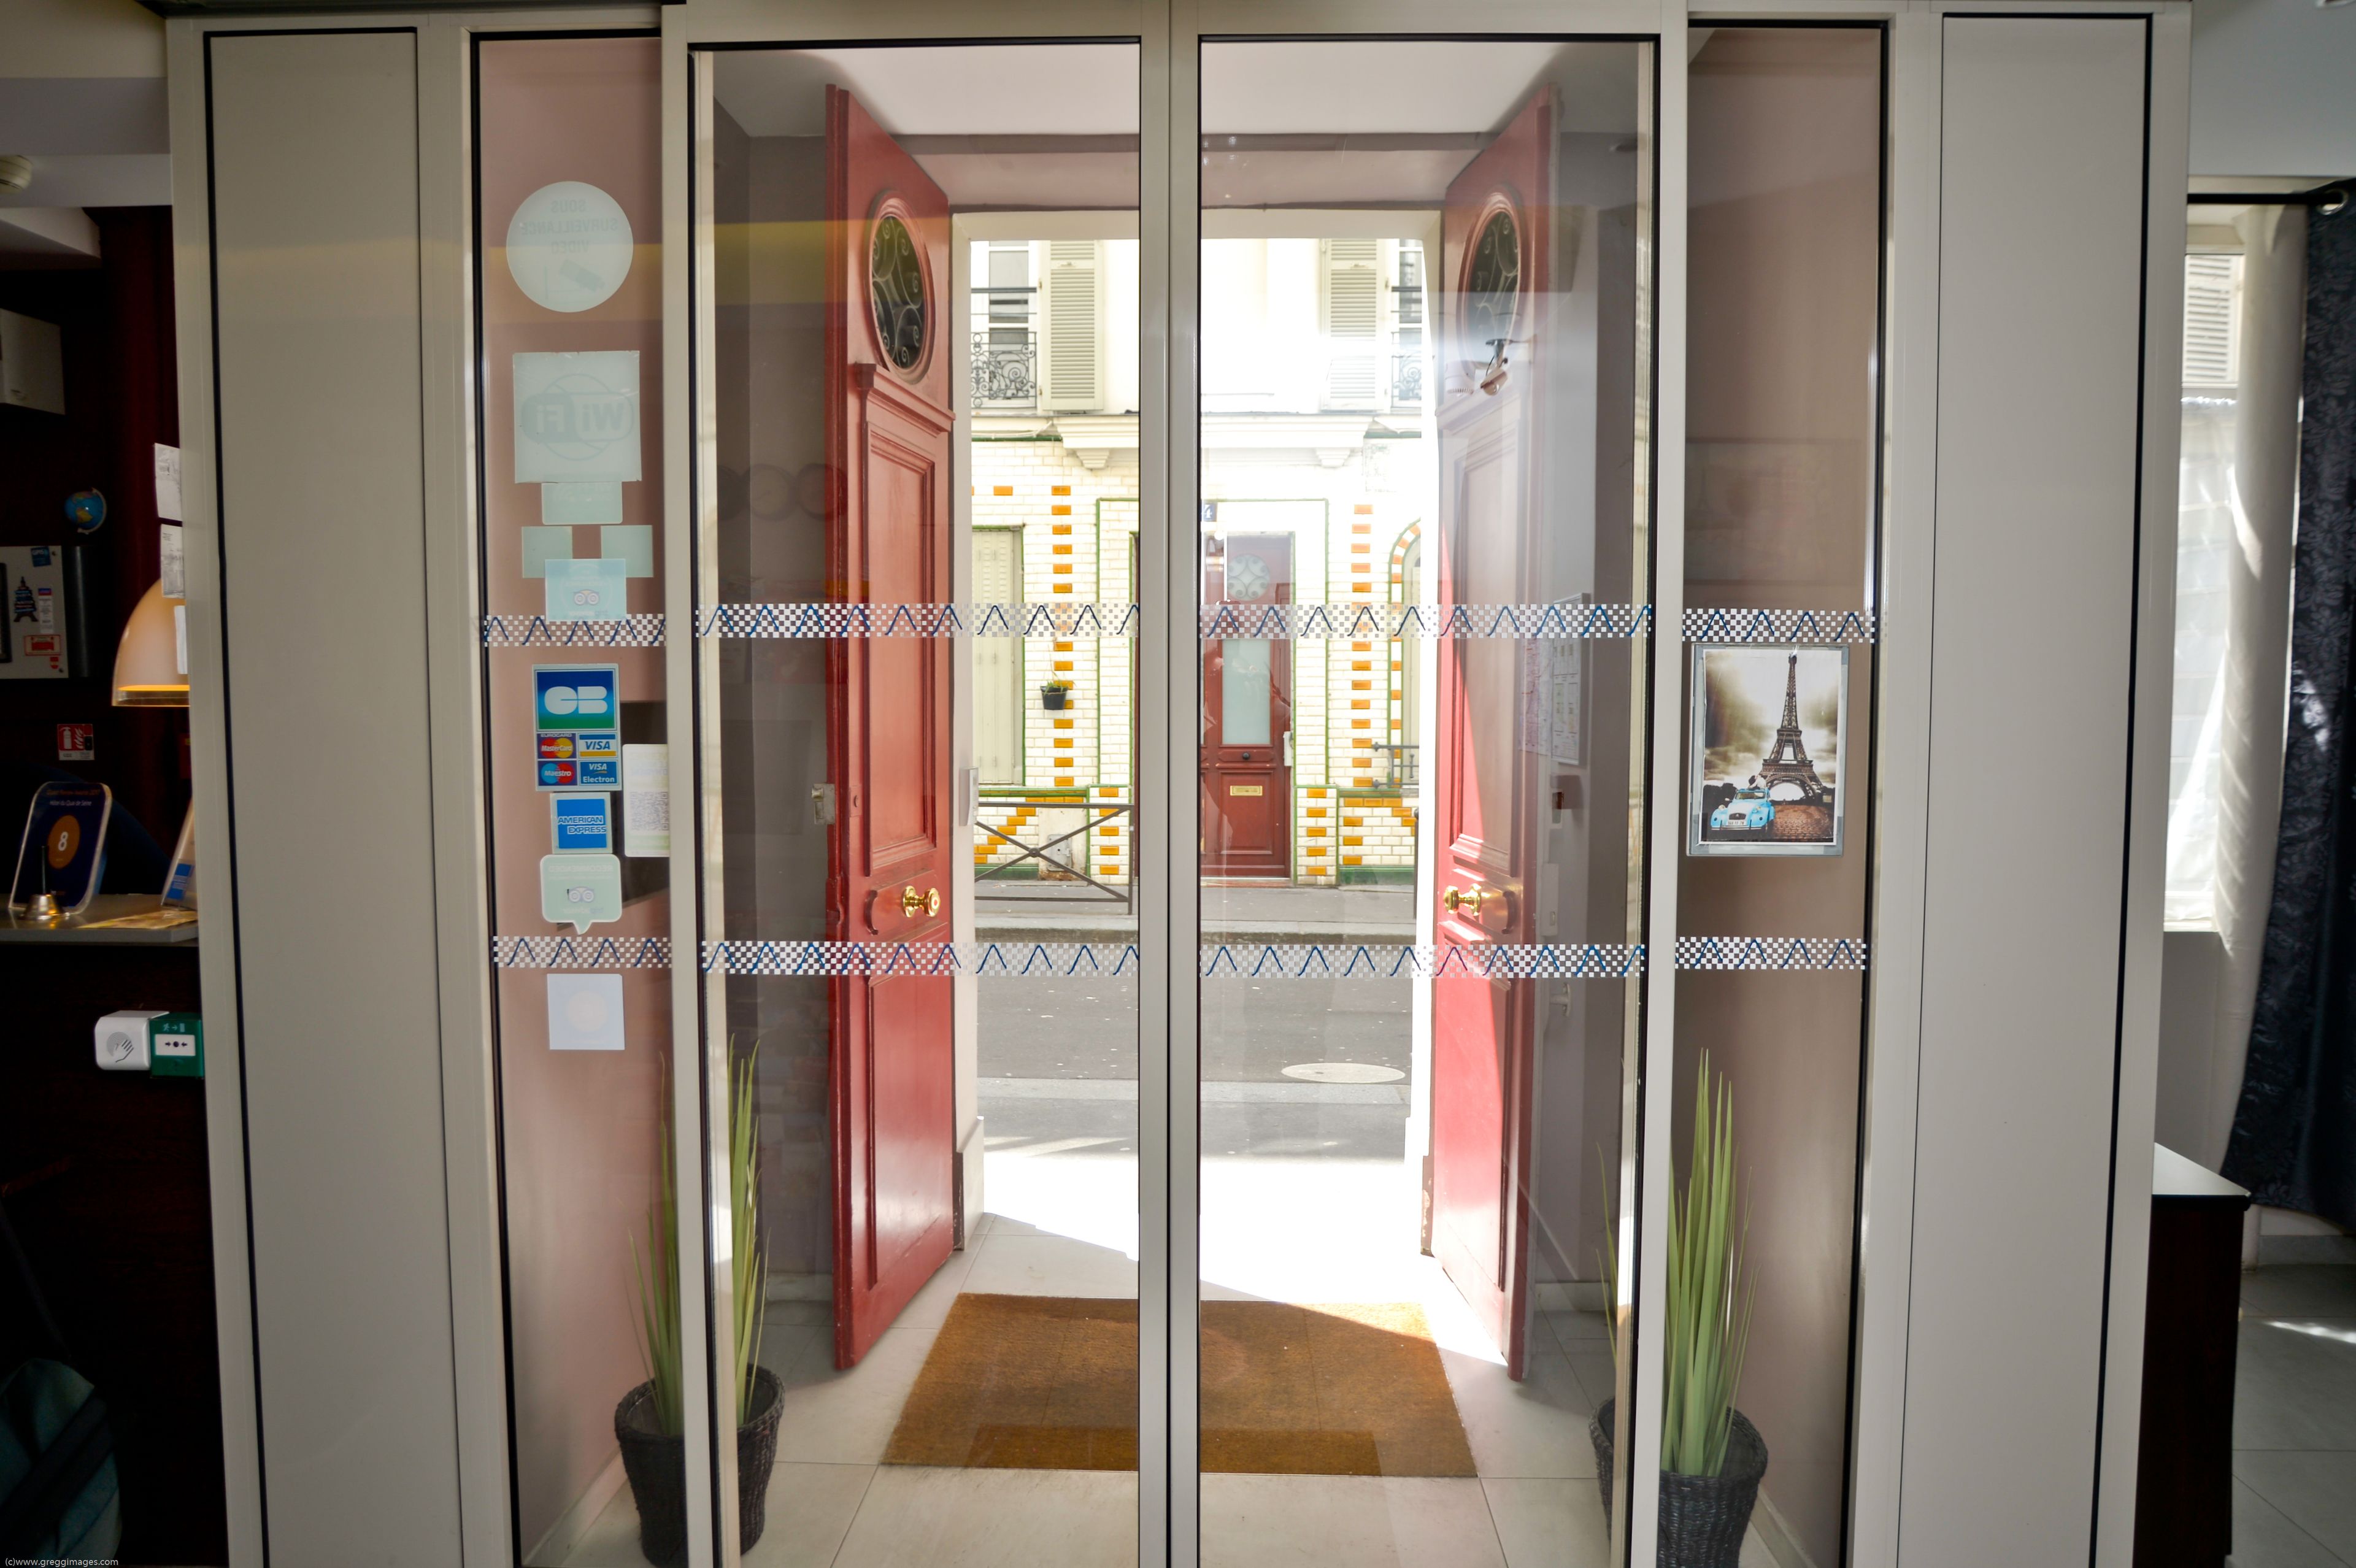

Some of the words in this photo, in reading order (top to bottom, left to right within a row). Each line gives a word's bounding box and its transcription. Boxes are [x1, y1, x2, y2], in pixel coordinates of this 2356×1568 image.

[585, 741, 610, 750] VISA
[558, 815, 604, 824] AMERICAN
[567, 826, 607, 834] EXPRESS
